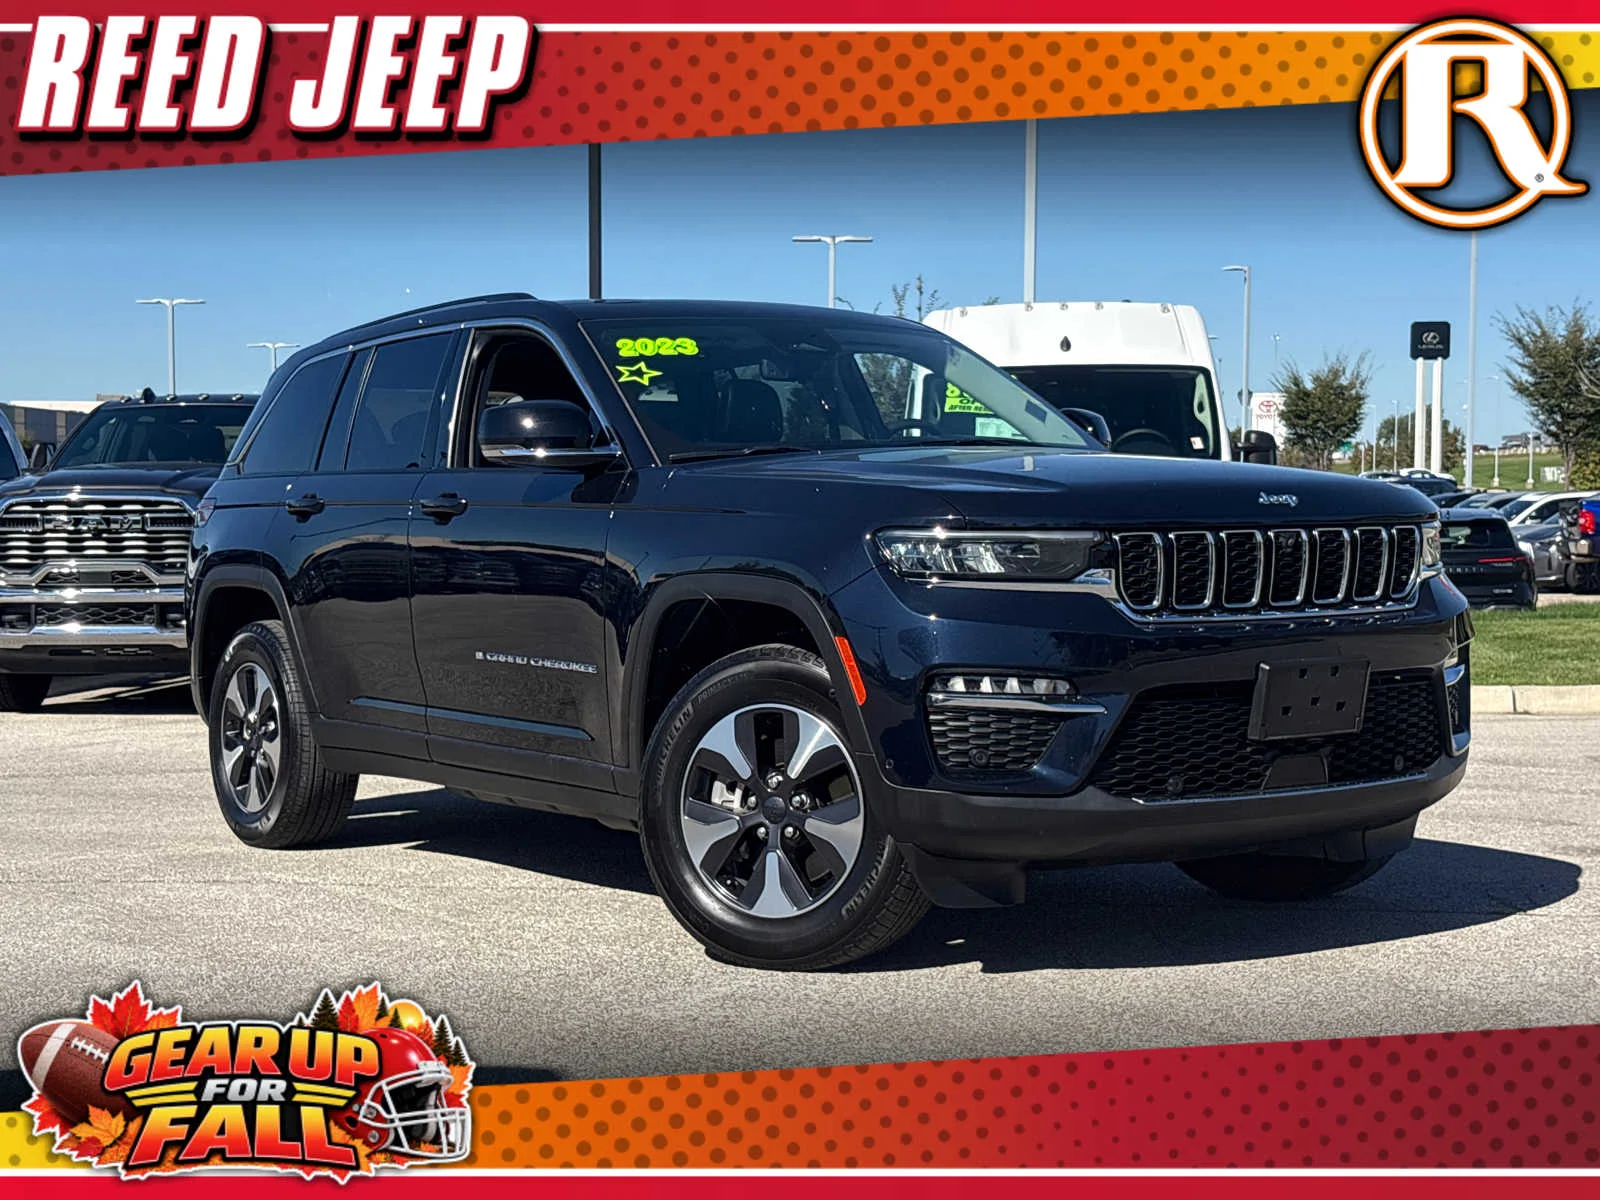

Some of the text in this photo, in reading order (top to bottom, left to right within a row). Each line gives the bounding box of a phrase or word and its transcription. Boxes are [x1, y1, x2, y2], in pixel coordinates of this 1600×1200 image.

[616, 337, 699, 357] 2023
[1258, 491, 1298, 507] Jeep
[43, 514, 143, 531] RAM
[486, 652, 598, 674] GRAND CHEROKEE
